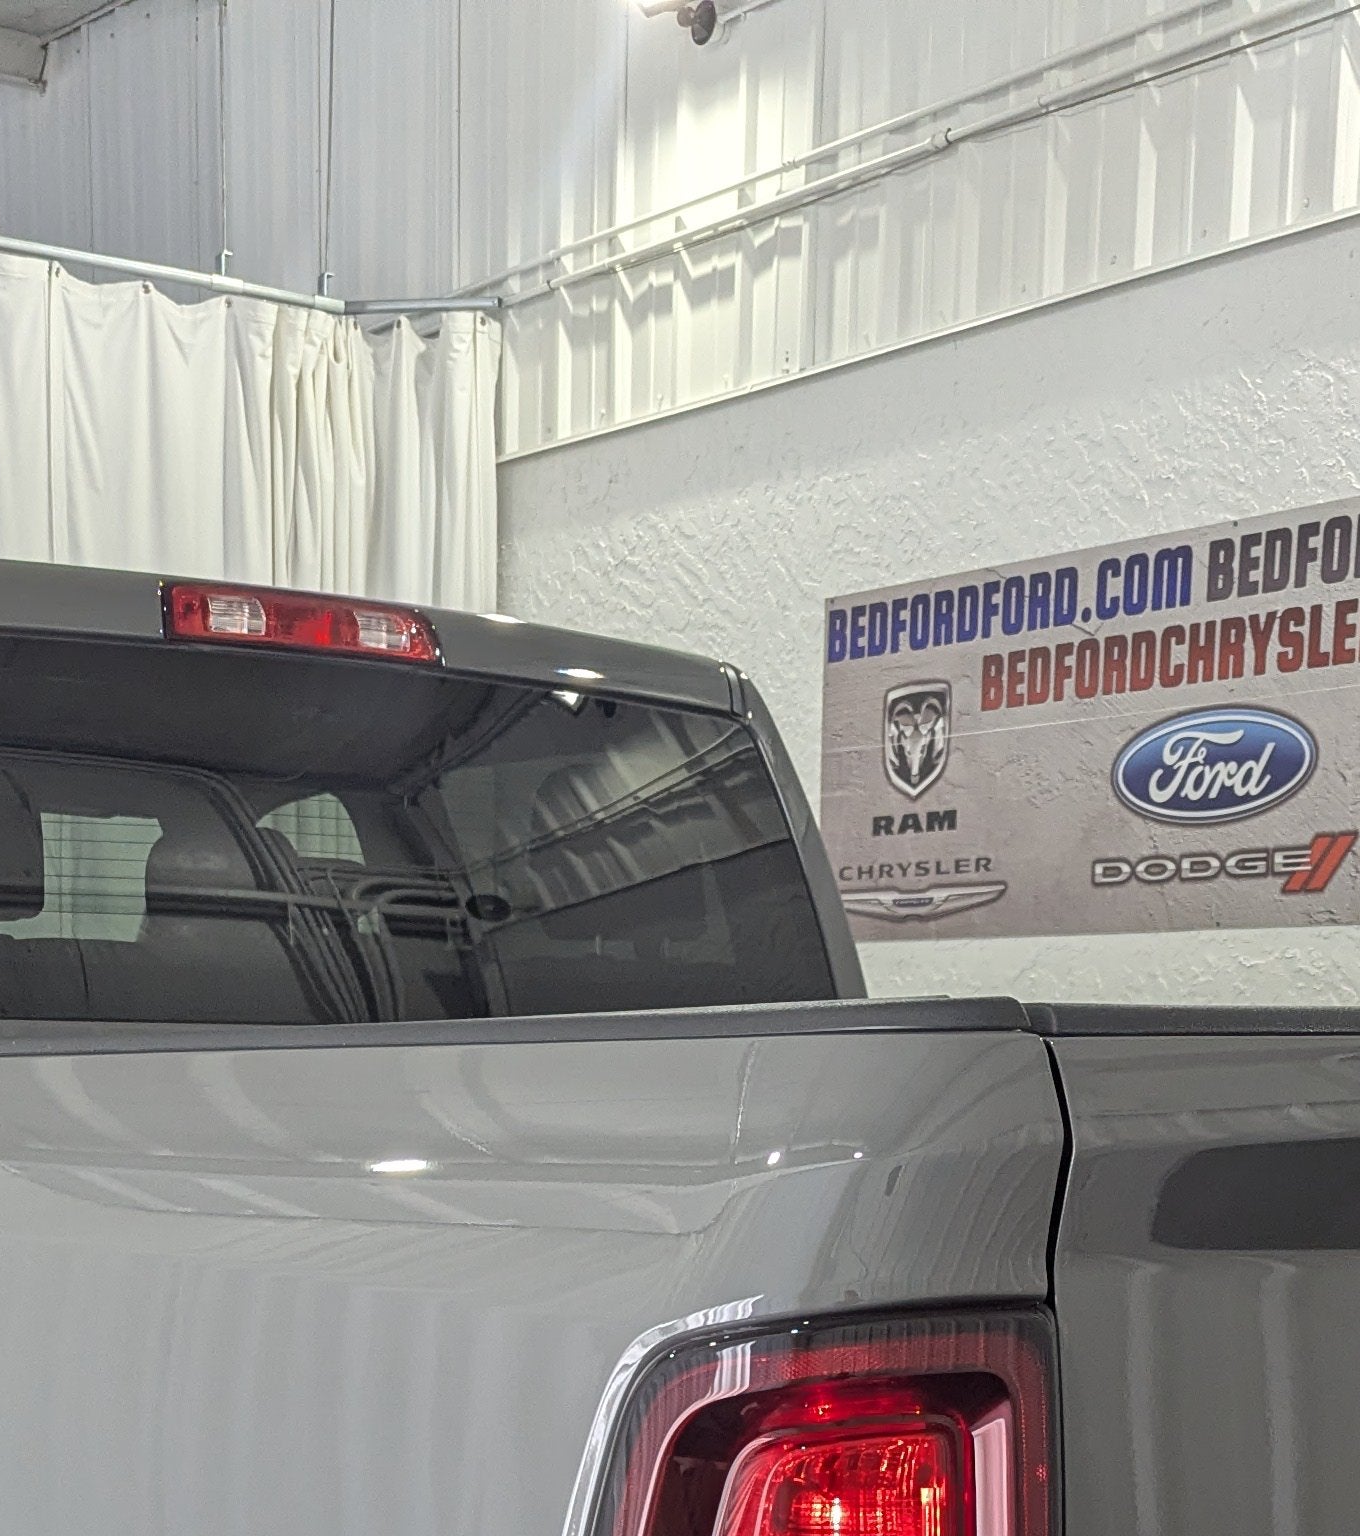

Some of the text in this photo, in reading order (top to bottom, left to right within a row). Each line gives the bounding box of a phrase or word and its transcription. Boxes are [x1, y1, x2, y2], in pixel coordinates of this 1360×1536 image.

[826, 545, 1193, 664] BEDFORDFORD.COM
[1148, 729, 1275, 803] Ford
[872, 810, 957, 837] RAM
[839, 857, 992, 881] CHRYSLER
[1093, 848, 1313, 886] DODGE
